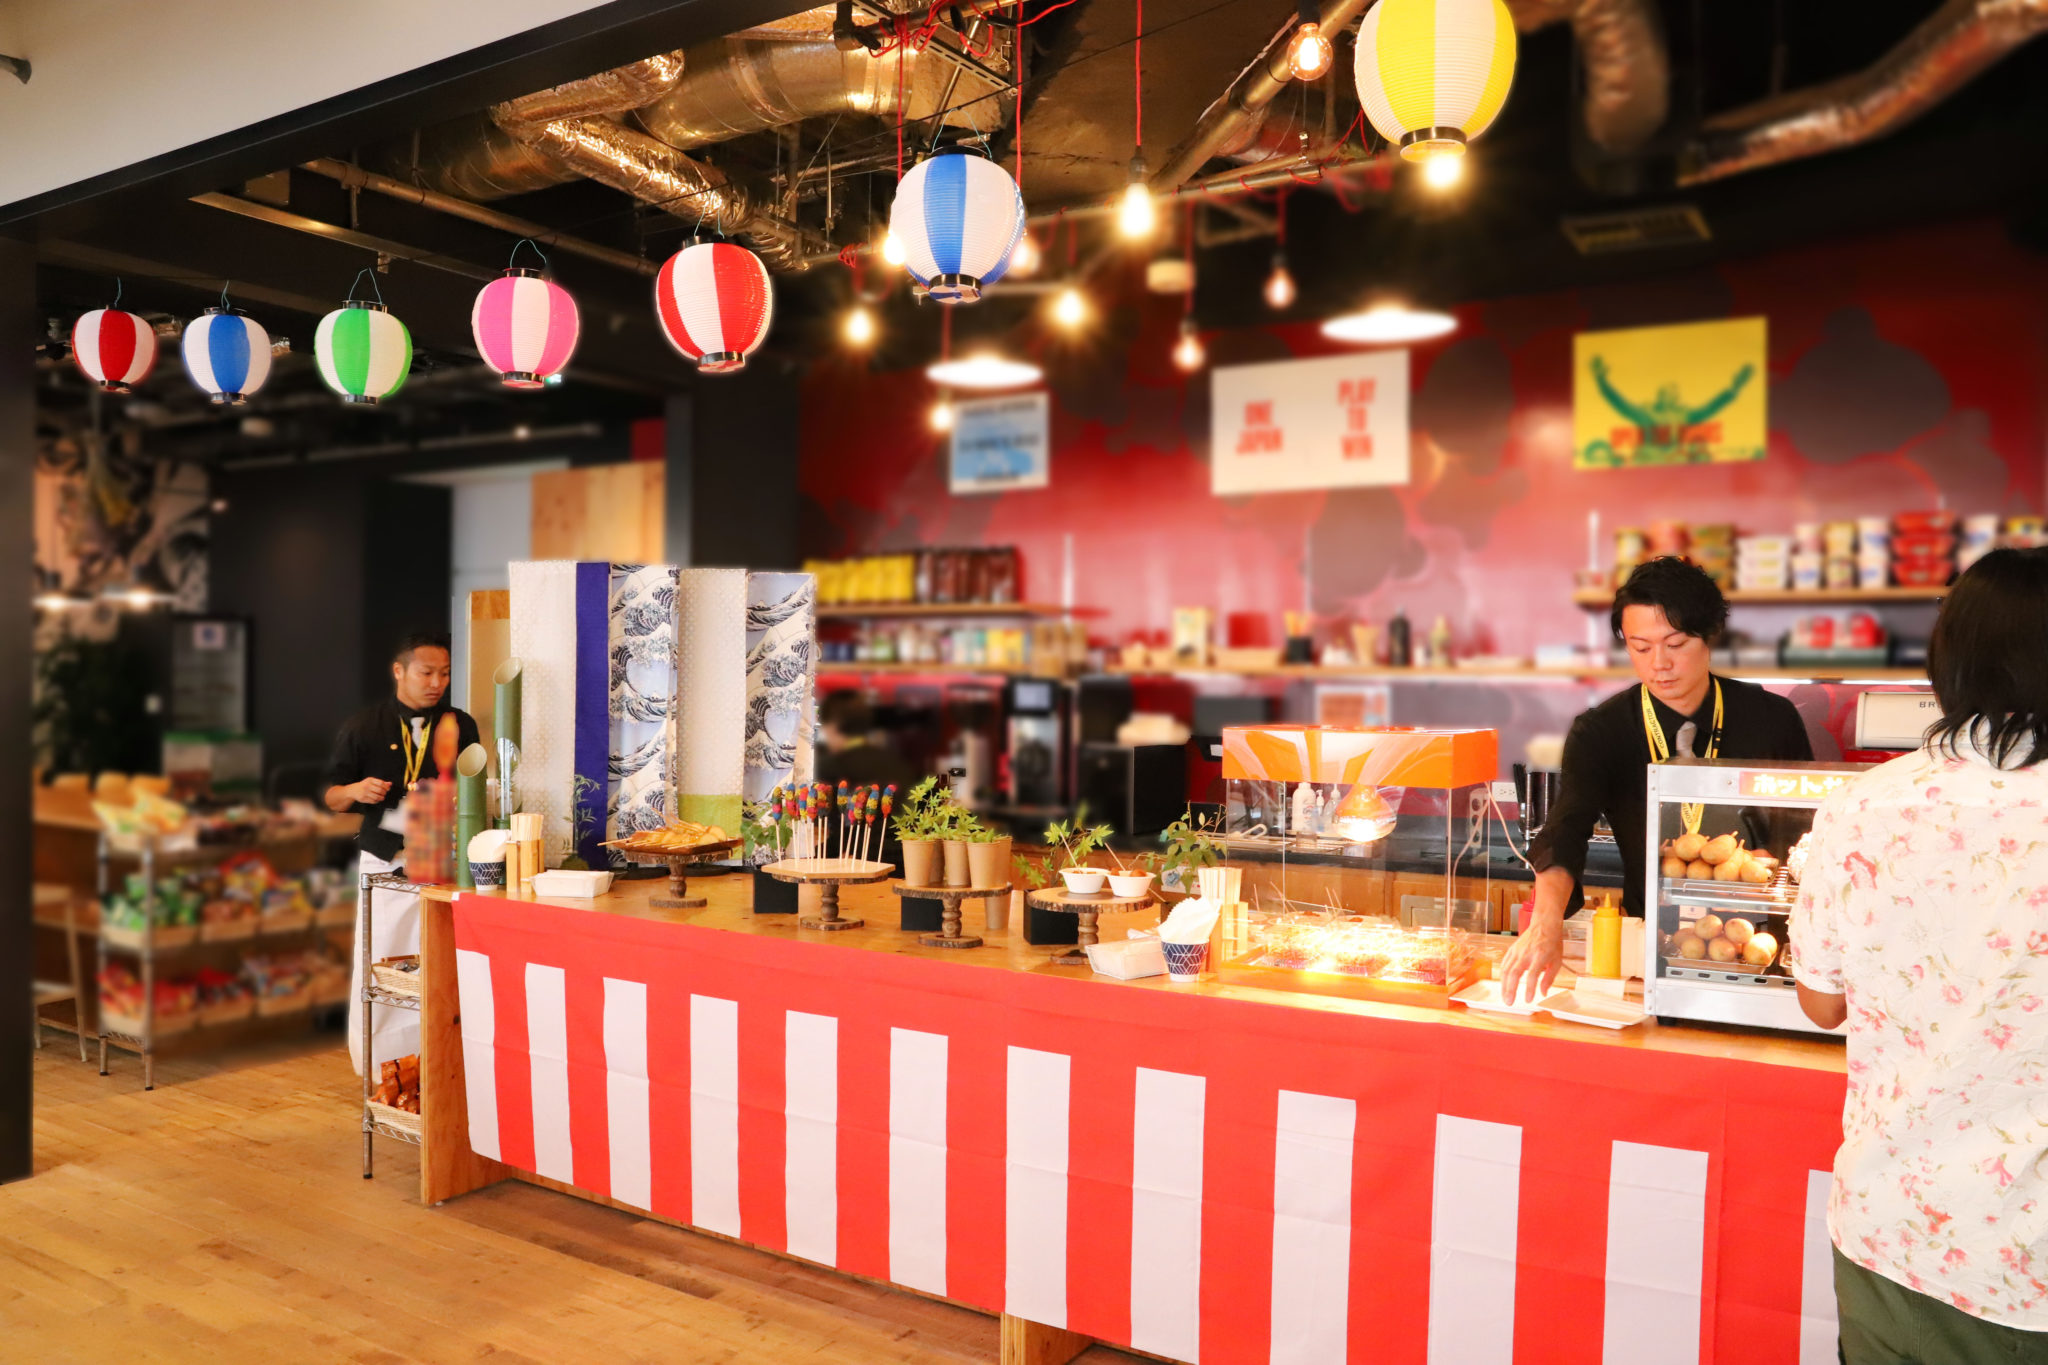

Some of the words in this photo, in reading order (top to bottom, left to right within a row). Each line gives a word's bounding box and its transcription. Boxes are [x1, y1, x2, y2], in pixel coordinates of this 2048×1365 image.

[1337, 378, 1377, 406] PLAY
[1340, 434, 1373, 460] WIN
[1646, 708, 1665, 749] CONTRACTOR
